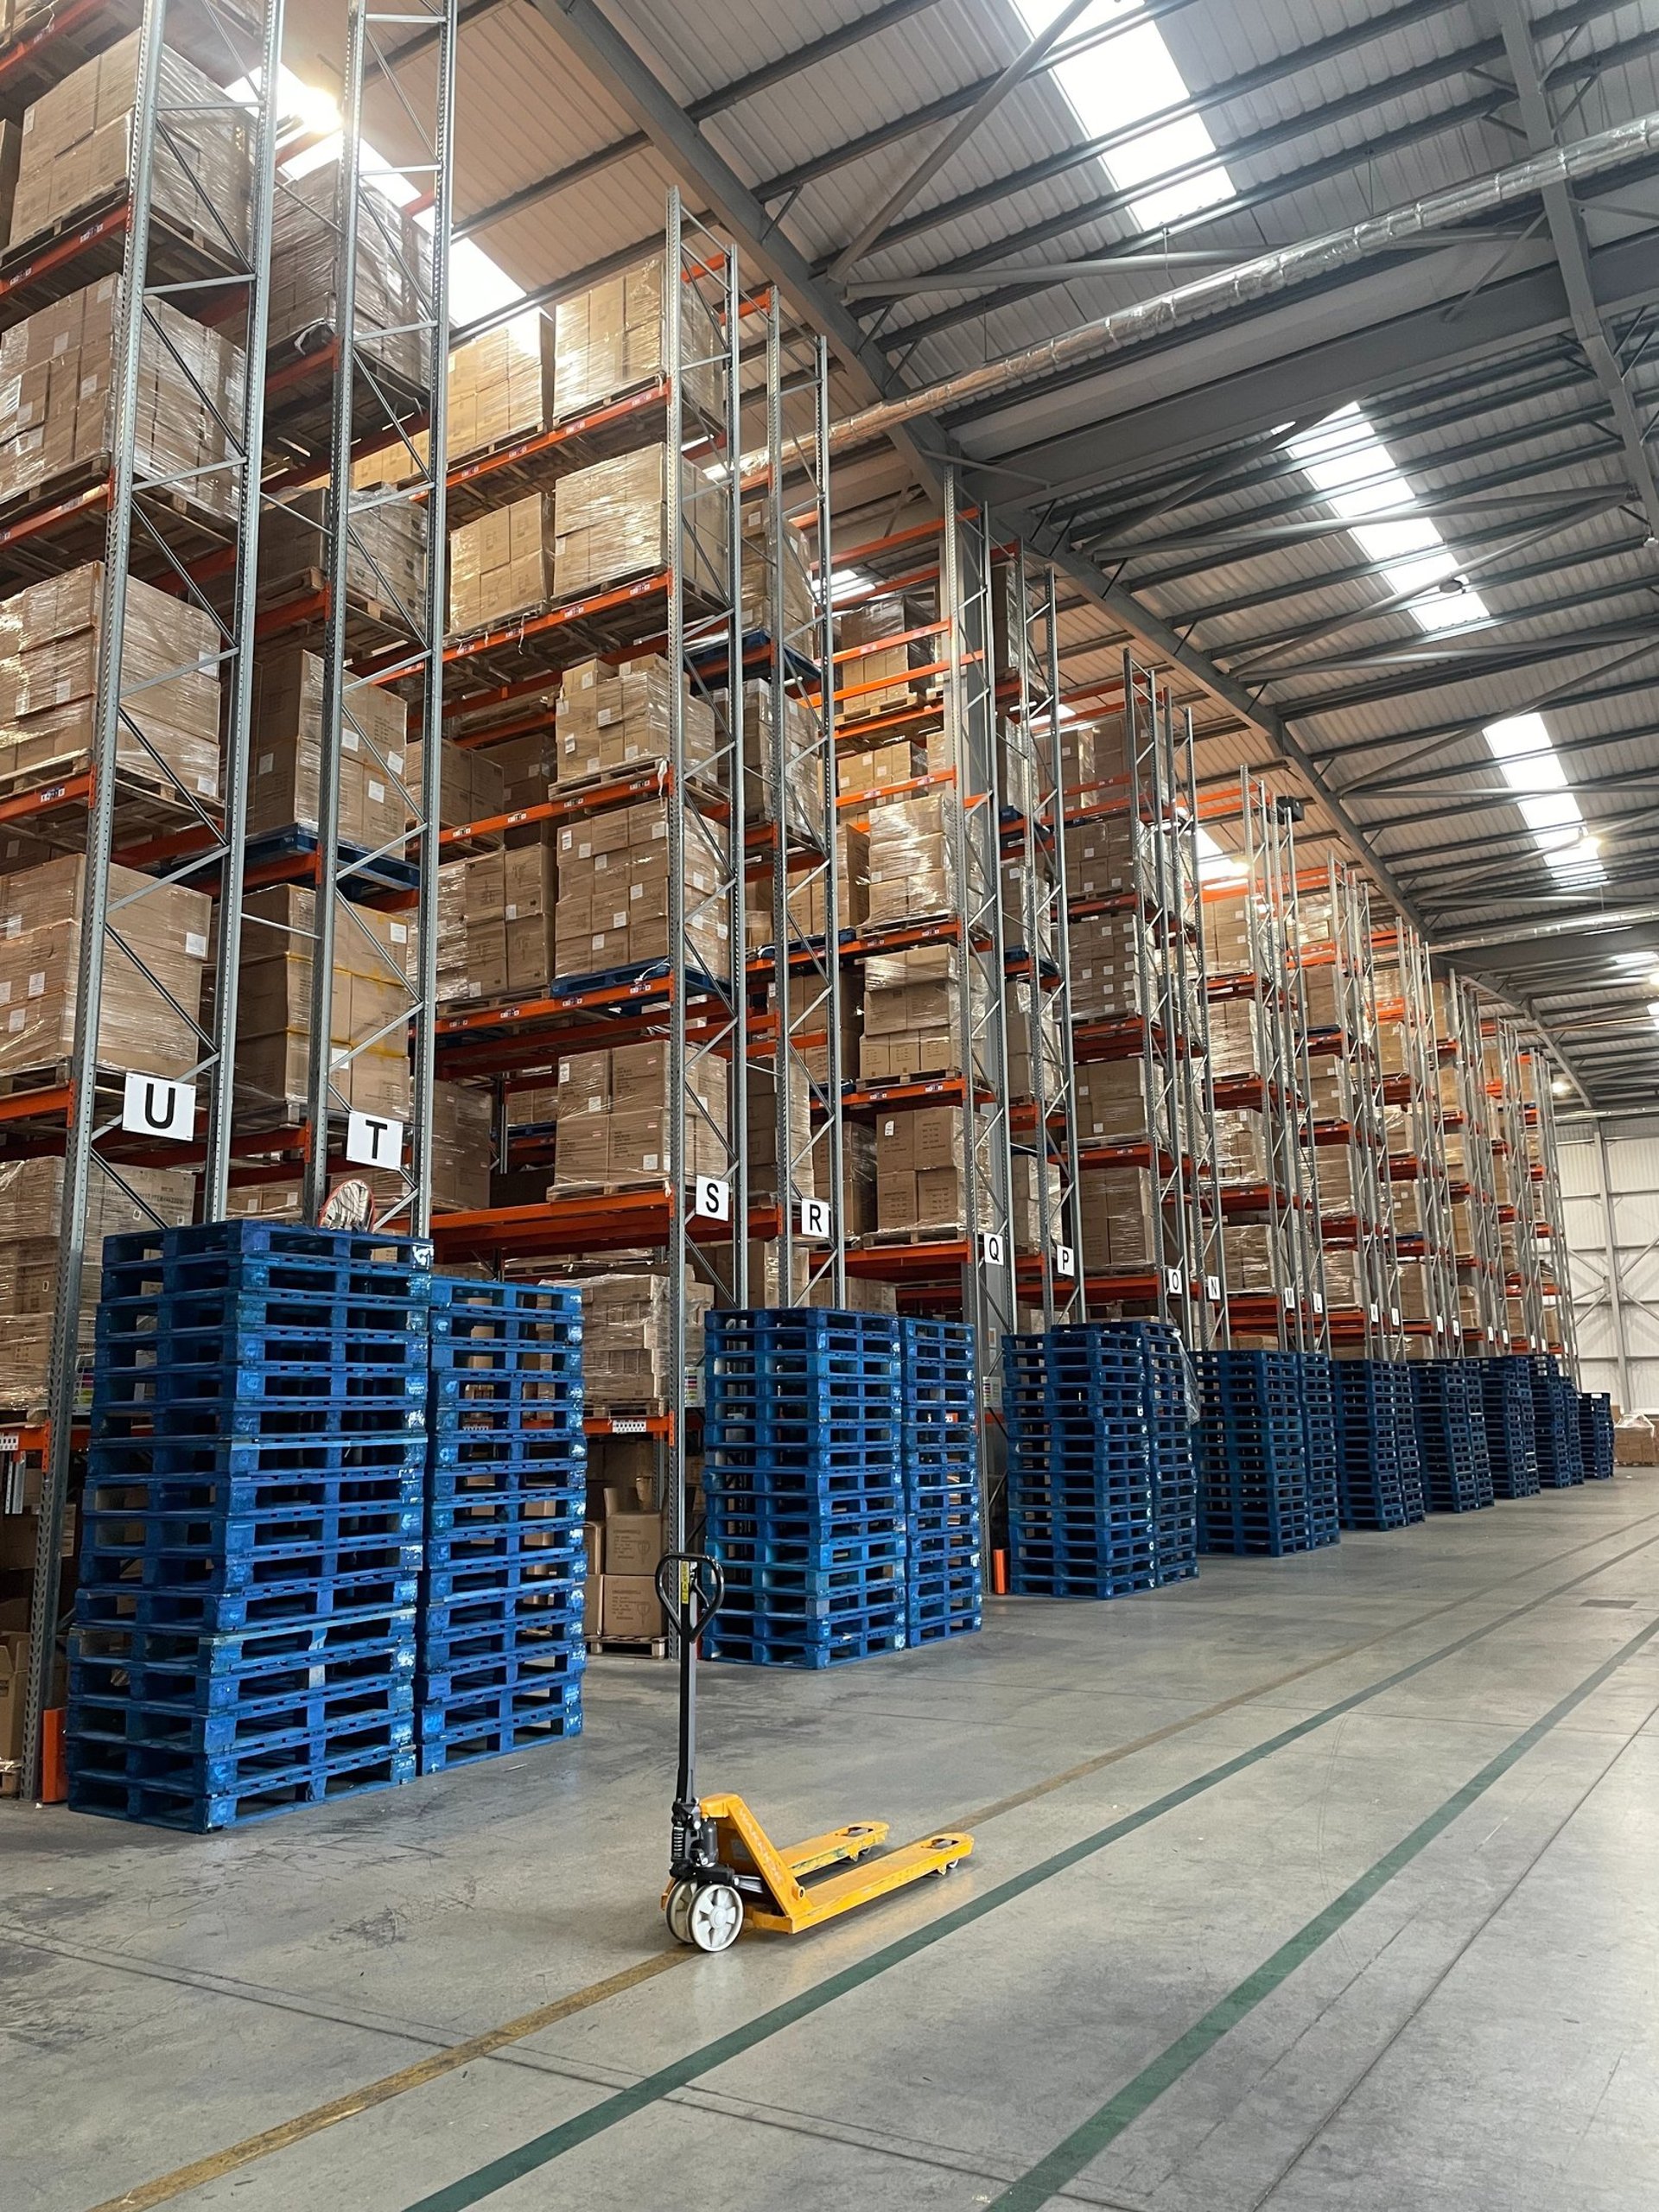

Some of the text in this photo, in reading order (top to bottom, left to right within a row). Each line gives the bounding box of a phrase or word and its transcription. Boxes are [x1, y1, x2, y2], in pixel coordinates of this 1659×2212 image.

[145, 1083, 175, 1128] U
[365, 1120, 387, 1159] T
[706, 1182, 720, 1214] S
[809, 1203, 823, 1233] R
[989, 1236, 1001, 1262] Q
[1062, 1249, 1070, 1270] P
[1172, 1272, 1179, 1290] O
[1211, 1279, 1217, 1296] N
